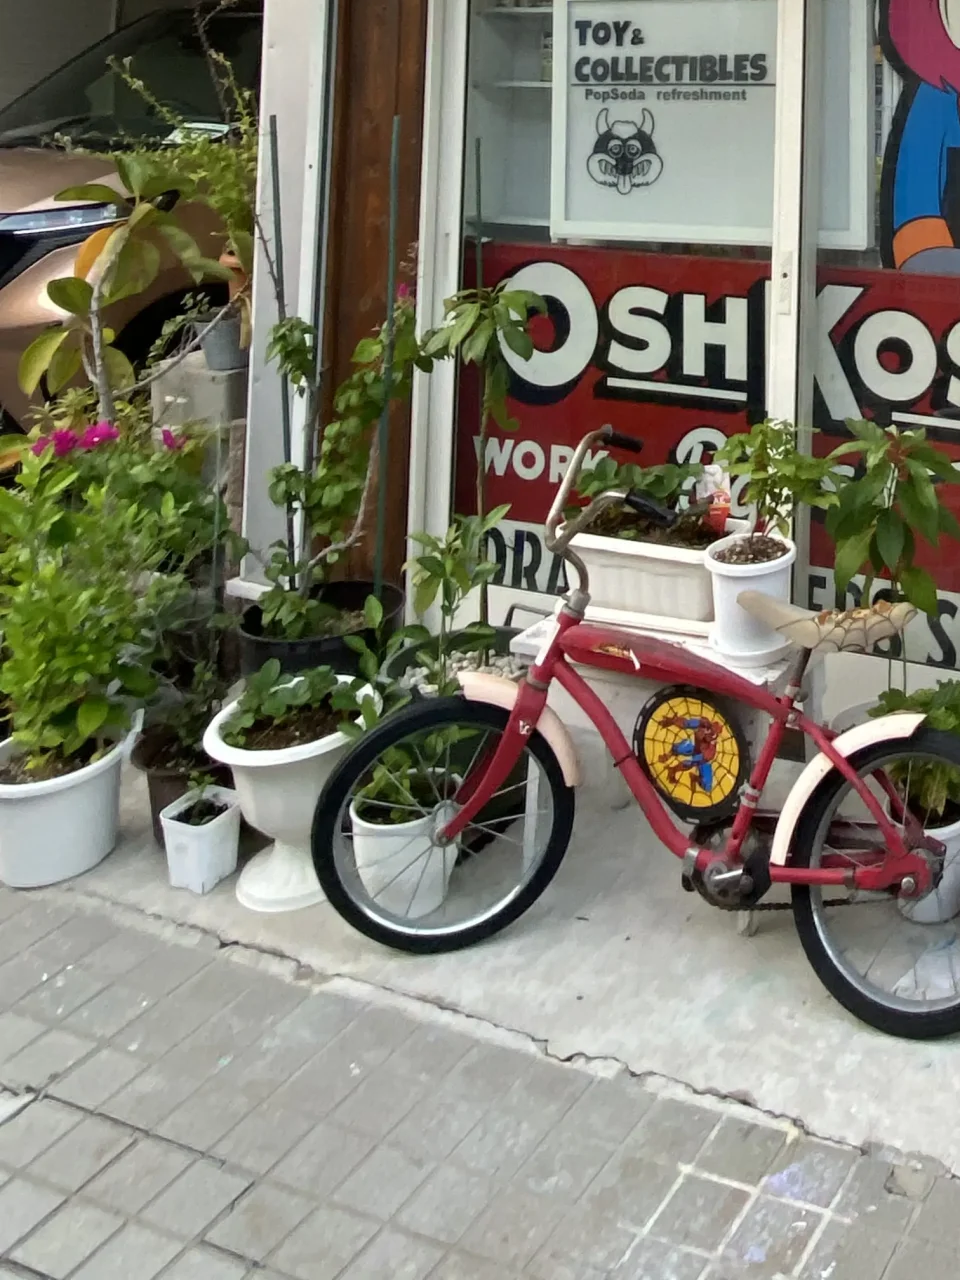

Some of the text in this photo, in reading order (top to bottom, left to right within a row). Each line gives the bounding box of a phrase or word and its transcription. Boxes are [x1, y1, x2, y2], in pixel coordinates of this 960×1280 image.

[574, 53, 769, 83] COLLECTIBLES
[585, 87, 747, 103] PopSoda refreshment
